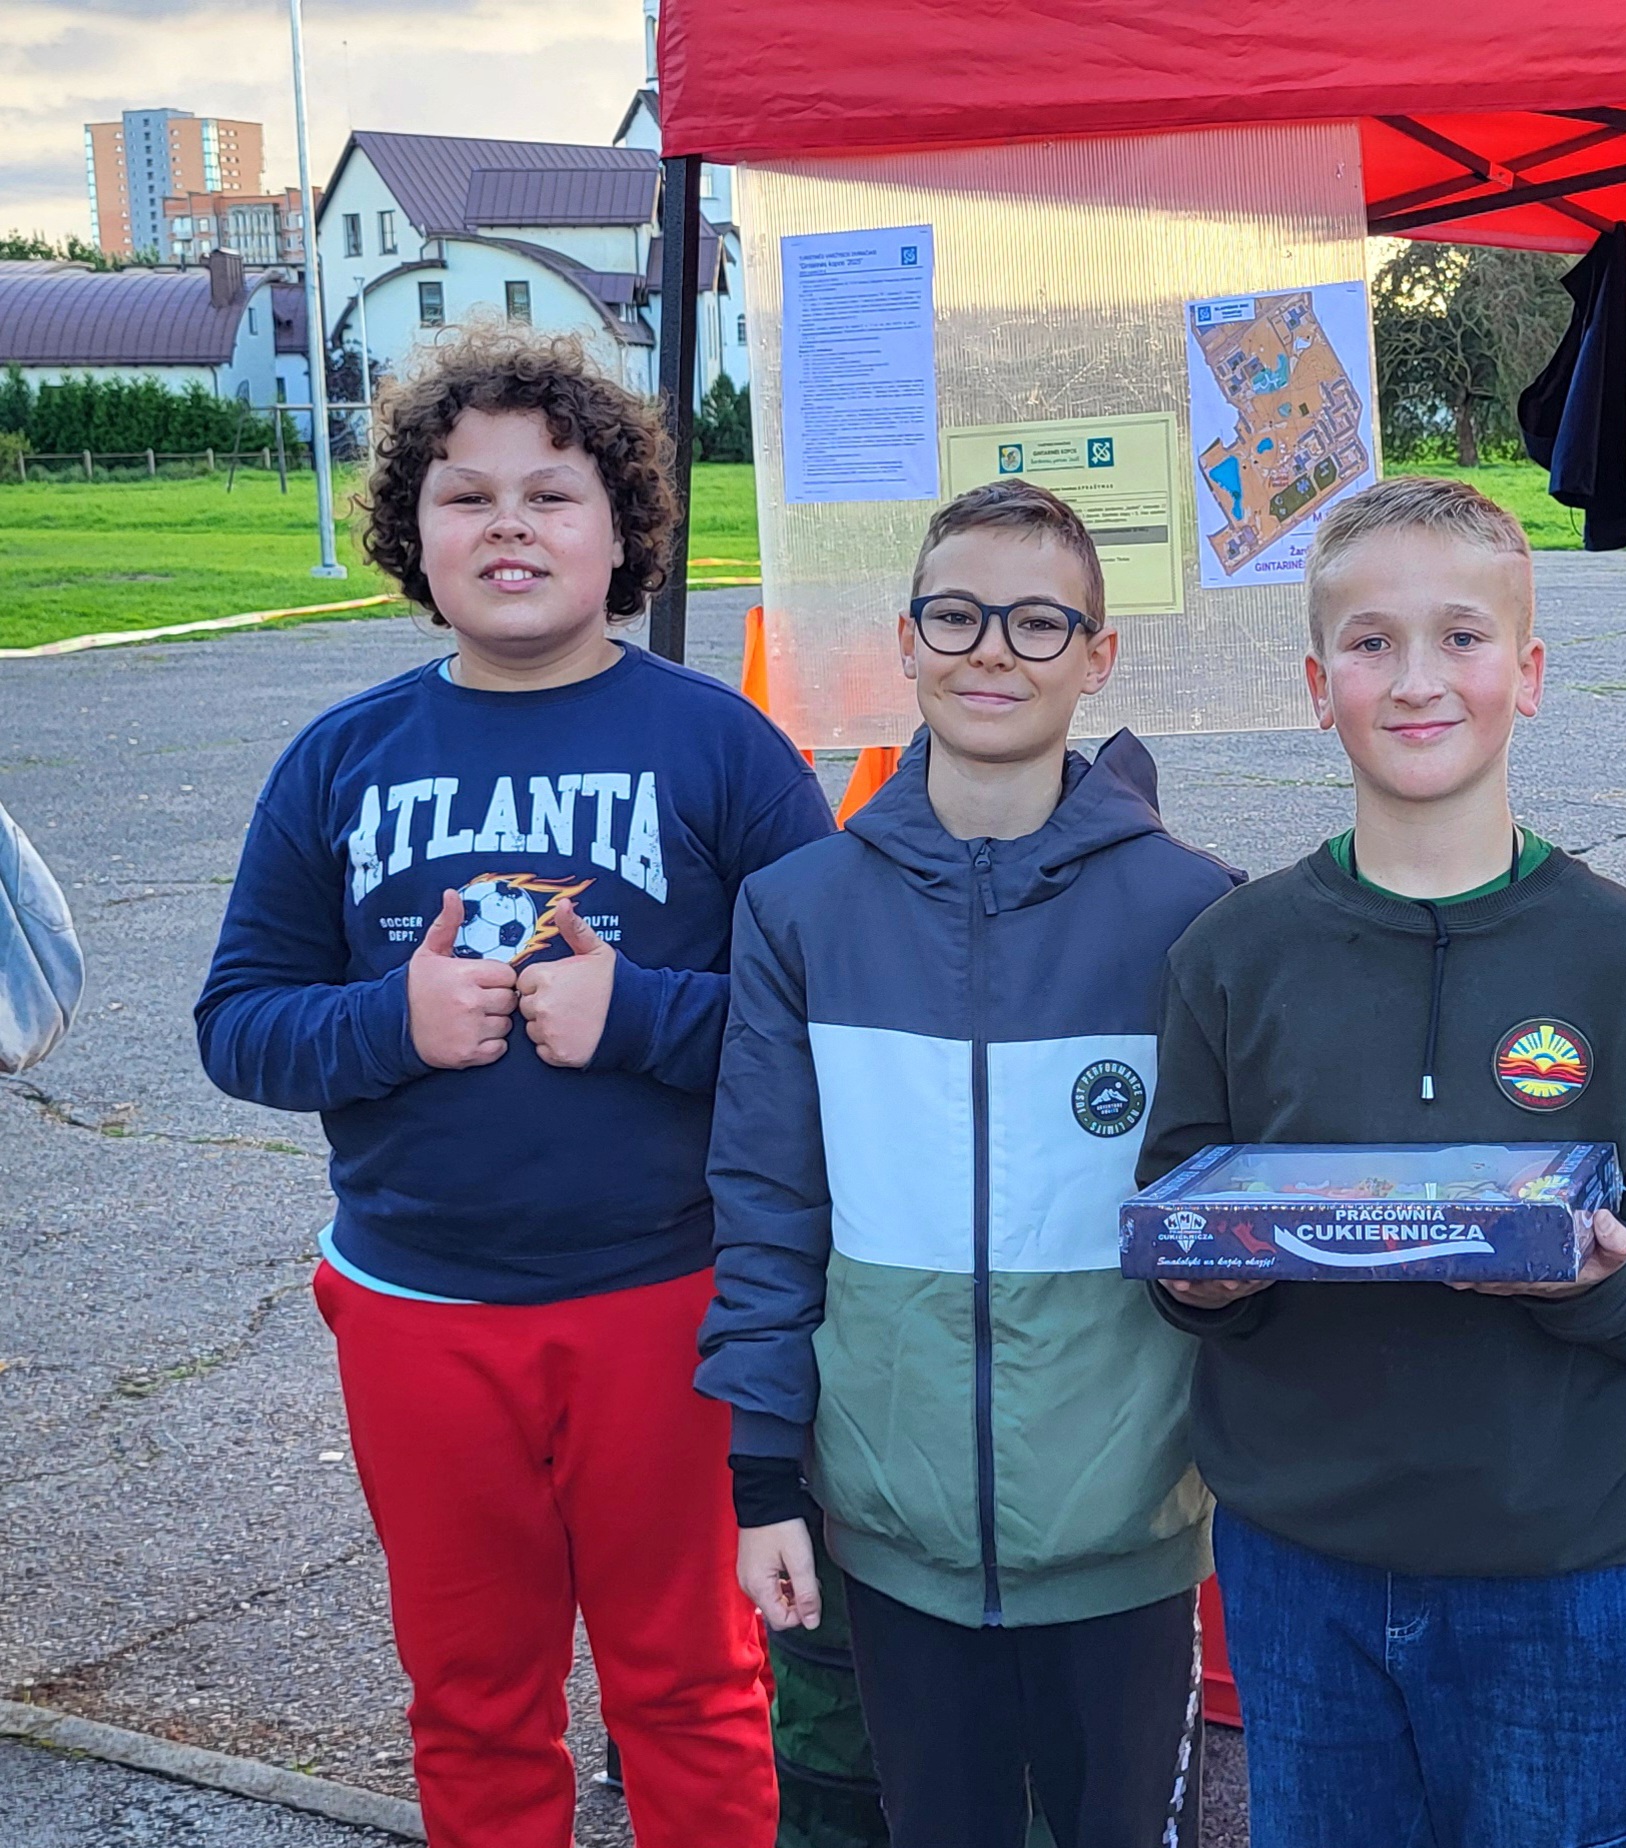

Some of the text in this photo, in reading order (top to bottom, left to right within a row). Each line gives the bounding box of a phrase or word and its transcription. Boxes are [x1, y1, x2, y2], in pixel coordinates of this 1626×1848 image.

[1255, 558, 1306, 572] GINTARINĖ
[349, 771, 668, 906] ATLANTA
[380, 916, 423, 928] SOCCER
[582, 915, 619, 927] OUTH
[388, 930, 418, 942] DEPT.
[1075, 1062, 1143, 1114] JUST PERFORMANCE
[1090, 1121, 1126, 1135] LIMITS
[1335, 1209, 1446, 1222] PRACOWNIA
[1296, 1224, 1486, 1241] CUKIERNICZA
